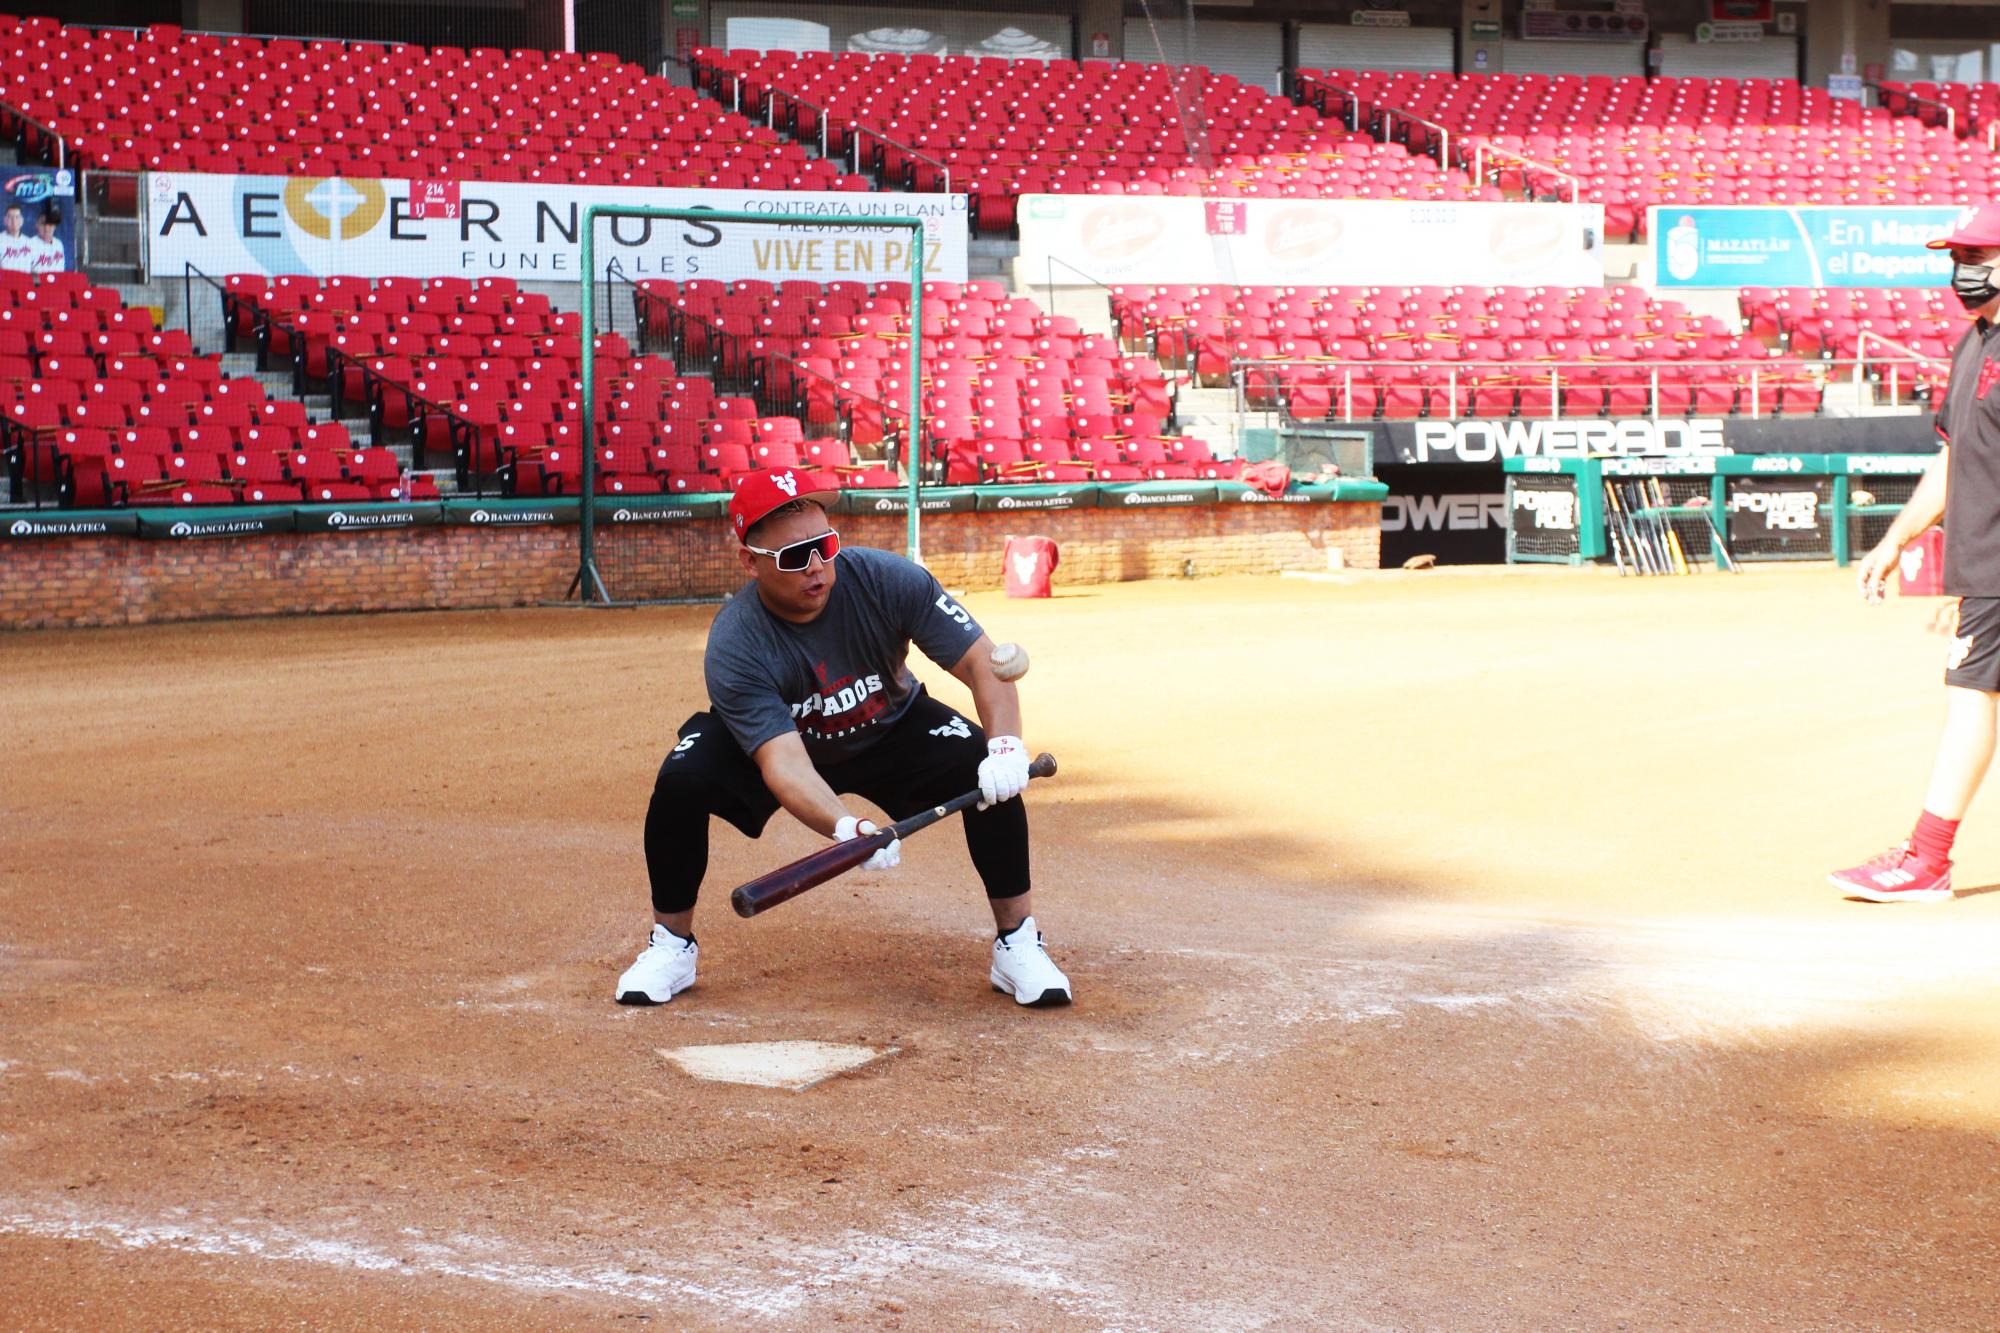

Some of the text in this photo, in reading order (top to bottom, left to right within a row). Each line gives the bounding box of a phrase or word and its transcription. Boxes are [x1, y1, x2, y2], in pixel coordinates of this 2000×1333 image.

[426, 183, 444, 196] 214
[744, 200, 945, 217] CONTRATA UN PLAN
[1828, 219, 1864, 246] En
[462, 250, 700, 274] FUNEALES
[753, 239, 823, 271] VIVE
[834, 240, 873, 272] EN
[1827, 252, 1954, 279] el Deporte
[1415, 418, 1724, 462] POWERADE
[1601, 457, 1717, 475] POWERADE
[1752, 457, 1789, 472] ARCO
[893, 500, 951, 510] BAN AZTECA
[1016, 496, 1073, 508] BANCO AZTECA
[1141, 494, 1194, 504] BANCO AZTECA
[1256, 493, 1311, 502] BAN AZTECA
[1513, 490, 1575, 512] POWER
[1732, 491, 1818, 513] POWER
[348, 512, 414, 525] BANCO AZTECA
[490, 511, 554, 522] BANCO AZTECA
[632, 509, 692, 521] BANCO AZTECA
[1766, 511, 1818, 530] ADE
[33, 520, 106, 534] BANCO AZTECA
[192, 520, 263, 535] BANCO AZTECA
[935, 593, 970, 625] 5
[799, 717, 878, 740] ASEBALL
[673, 732, 702, 752] 5
